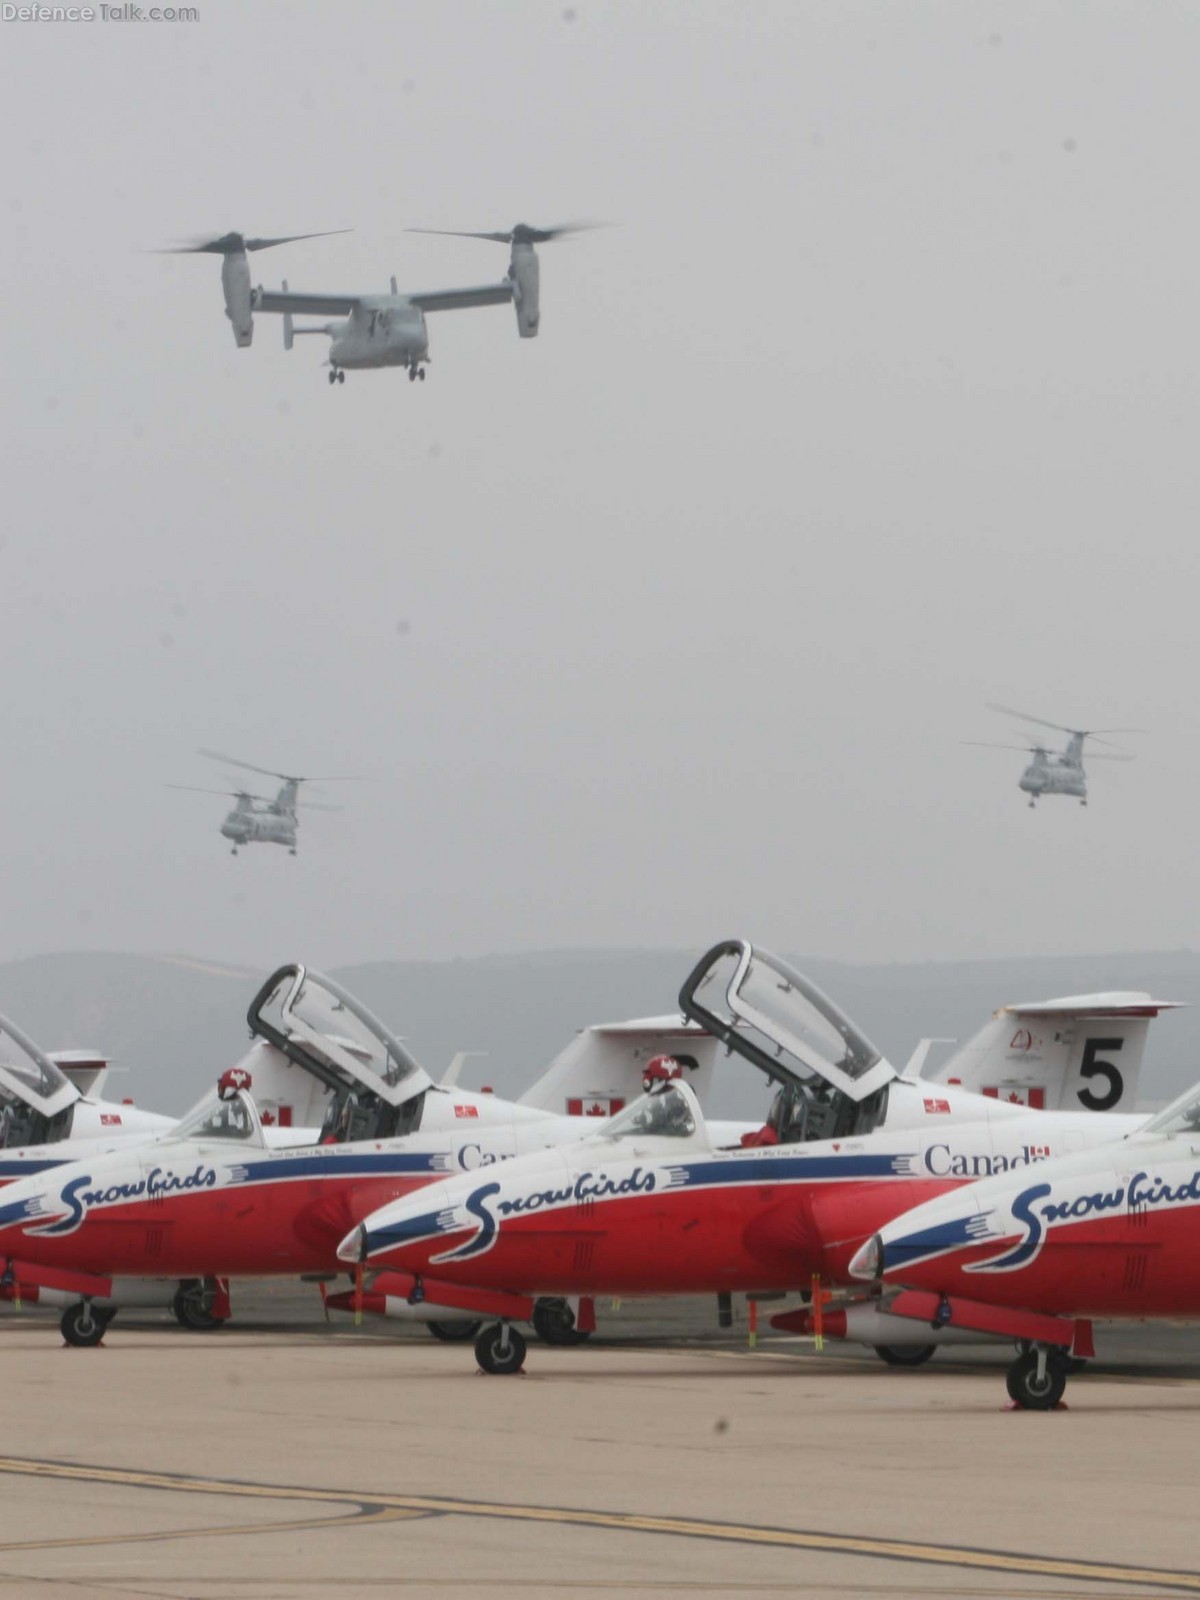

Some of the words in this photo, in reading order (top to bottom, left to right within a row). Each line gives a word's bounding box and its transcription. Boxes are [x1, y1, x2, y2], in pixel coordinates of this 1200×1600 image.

[1077, 1037, 1124, 1111] 5
[924, 1144, 1046, 1177] Canad
[24, 1165, 216, 1236] Snowbirds
[430, 1167, 656, 1264] Snowbirds
